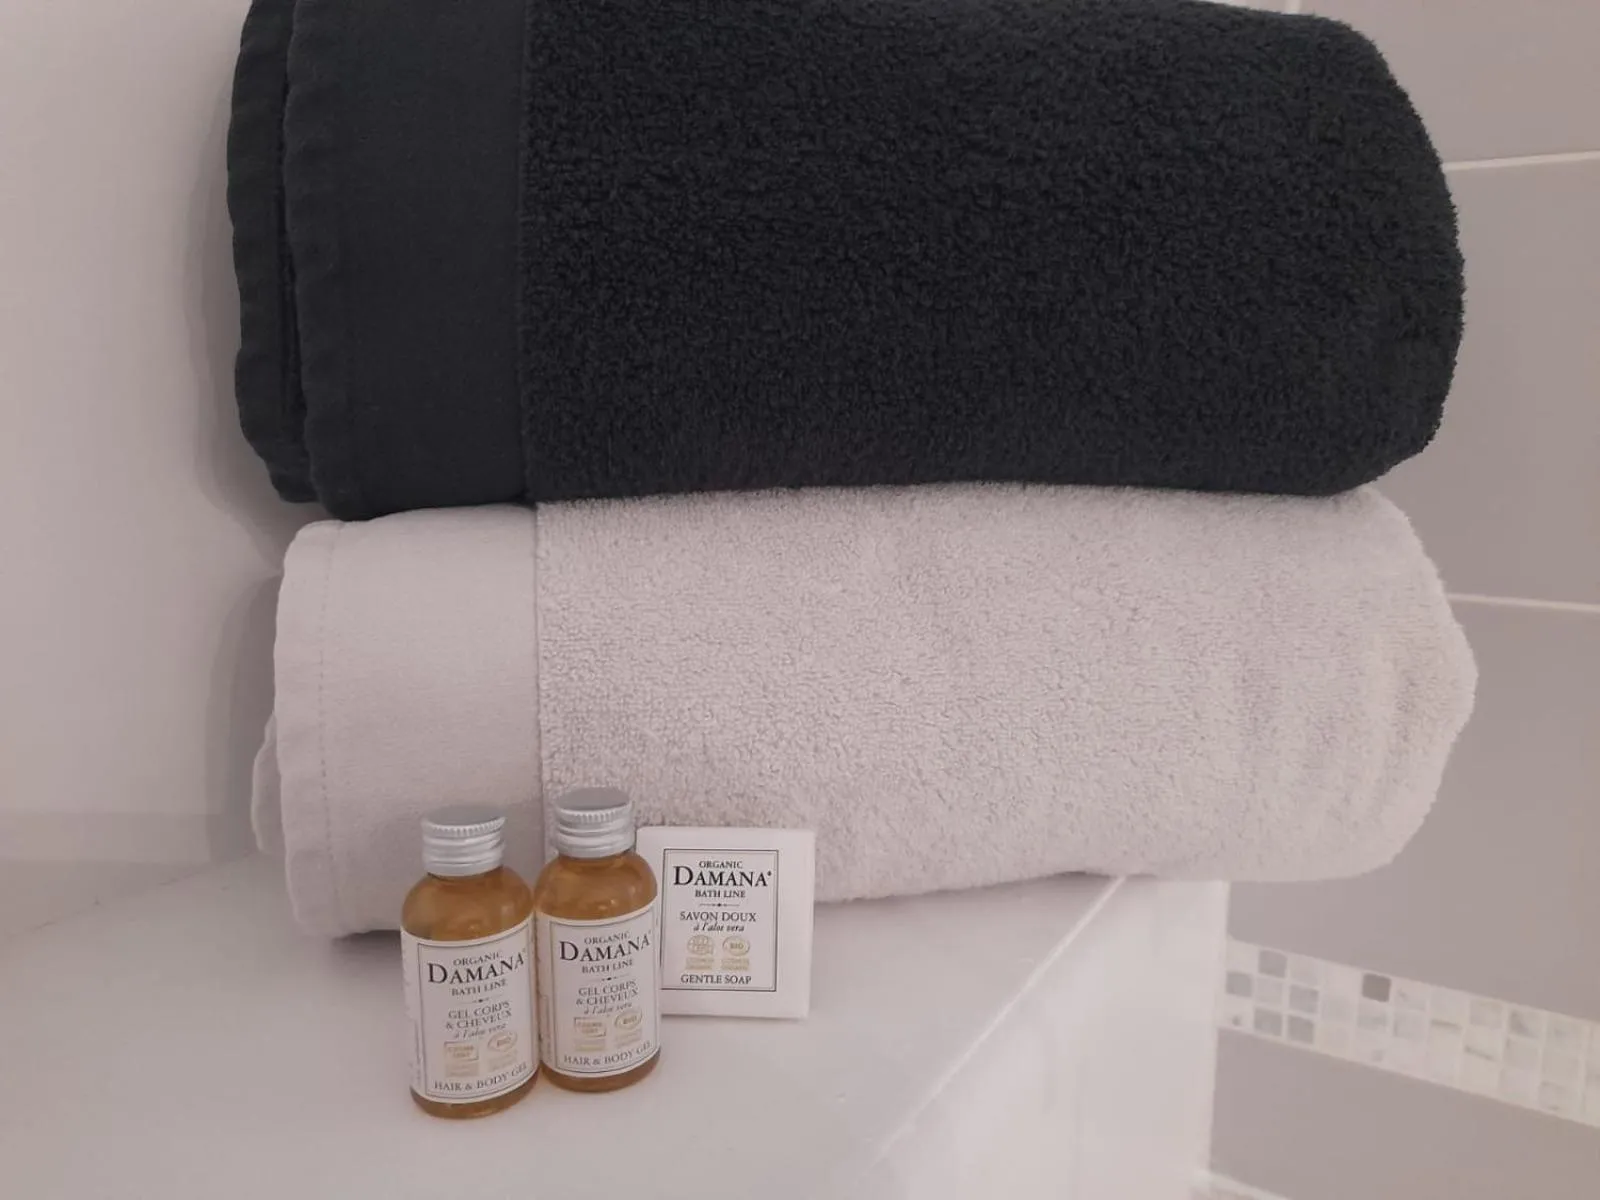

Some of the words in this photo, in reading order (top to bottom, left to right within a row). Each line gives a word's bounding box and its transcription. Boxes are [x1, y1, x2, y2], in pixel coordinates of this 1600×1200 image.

[699, 860, 743, 870] ORGANIC
[673, 865, 768, 888] DAMANA
[694, 889, 721, 898] BATH
[723, 889, 746, 898] LINE
[680, 911, 718, 922] SAVON
[721, 912, 757, 923] DOUX
[726, 924, 745, 932] vera
[583, 931, 631, 945] ORGANIC
[729, 941, 744, 950] BIO
[559, 934, 651, 962] DAMANA
[427, 952, 526, 985] DAMANA
[452, 952, 502, 967] ORGANIC
[581, 963, 610, 974] BATH
[612, 959, 634, 971] LINE
[451, 985, 481, 997] BATH
[483, 978, 507, 992] LINE
[578, 985, 600, 997] GEL
[602, 979, 637, 995] CORPS
[680, 974, 723, 985] GENTLE
[724, 974, 752, 986] SOAP
[586, 988, 639, 1006] CHEVEUX
[448, 1008, 469, 1020] GEL
[474, 1001, 510, 1017] CORPS
[446, 1022, 453, 1030] &
[456, 1010, 513, 1029] CHEVEUX
[563, 1054, 592, 1067] HAIR
[604, 1049, 634, 1066] BODY
[434, 1080, 462, 1091] HAIR
[465, 1083, 473, 1091] &
[477, 1071, 510, 1089] BODY
